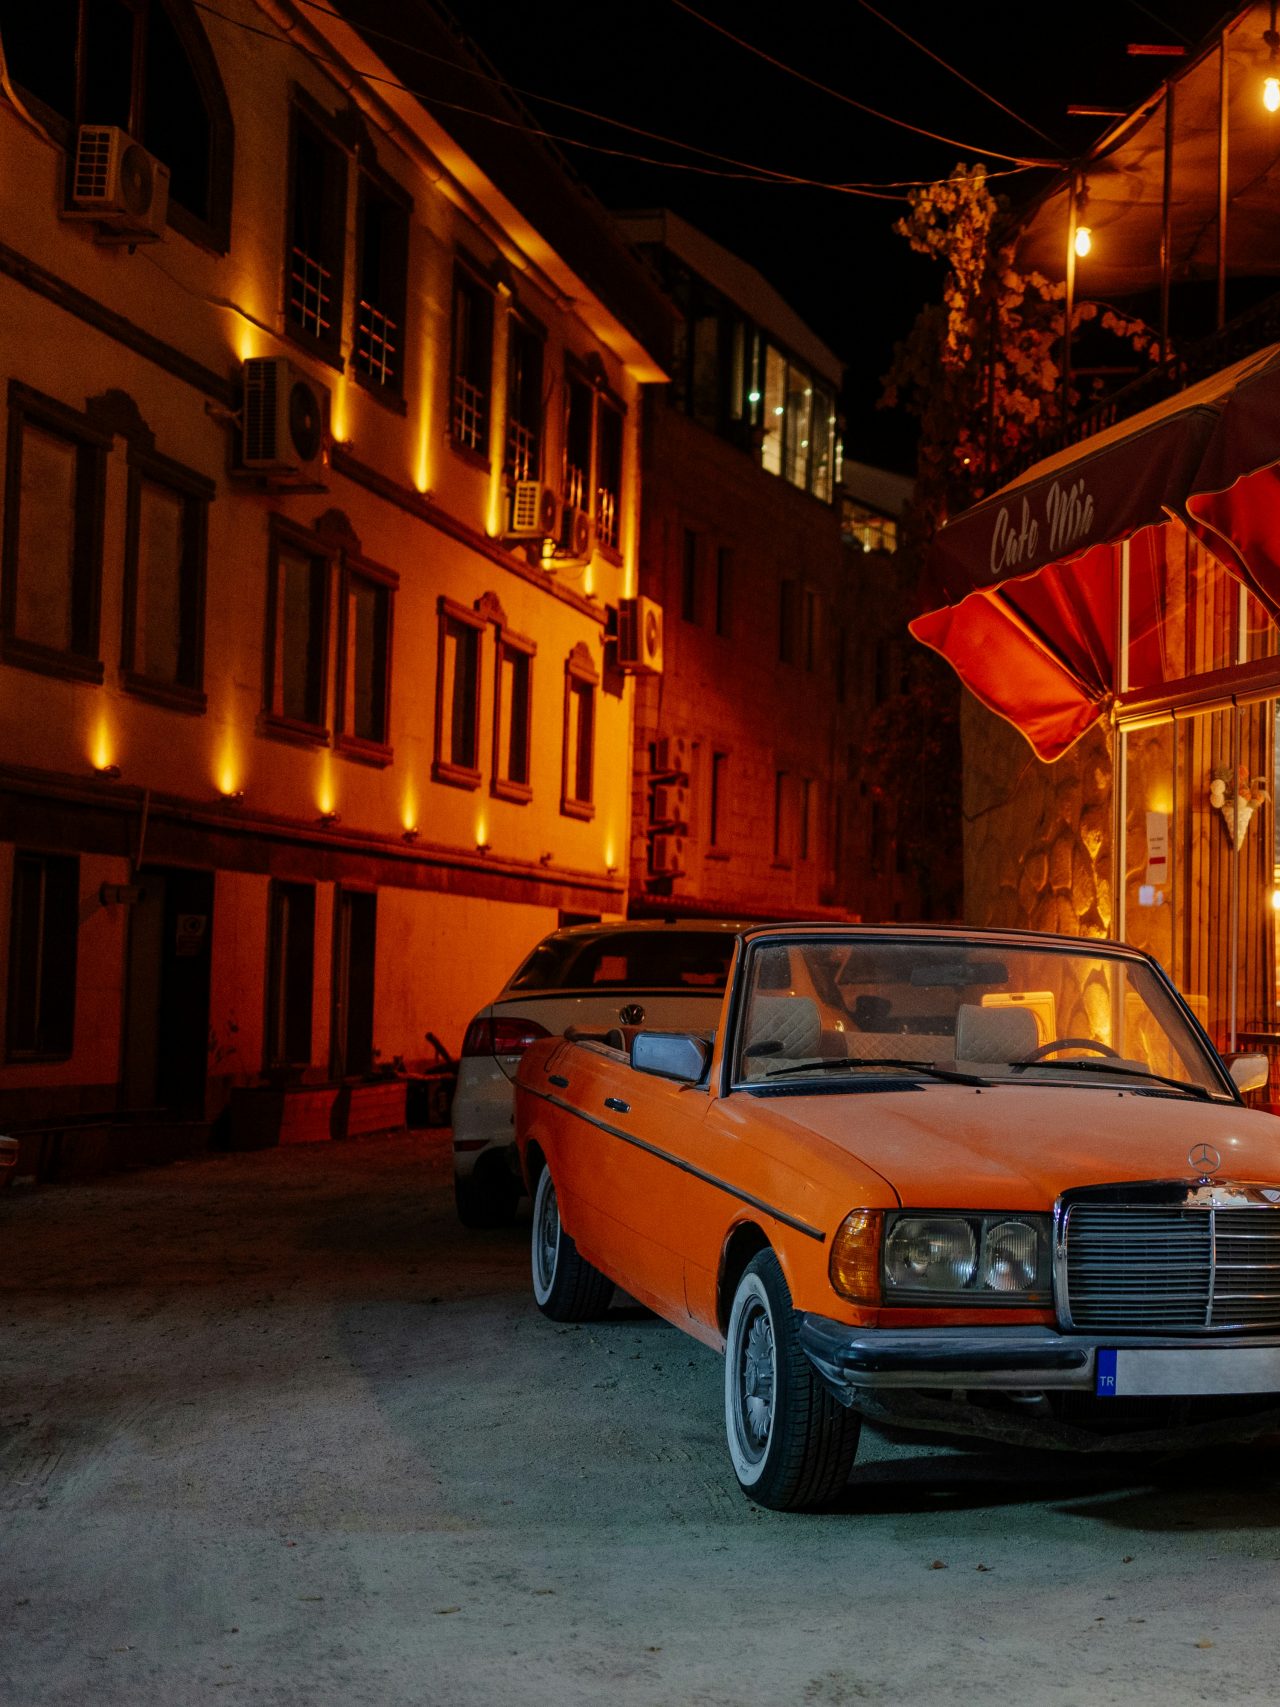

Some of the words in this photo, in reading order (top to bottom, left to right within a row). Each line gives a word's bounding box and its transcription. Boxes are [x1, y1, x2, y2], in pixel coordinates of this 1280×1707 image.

[990, 496, 1038, 574] Cafe
[1046, 478, 1094, 552] Mia
[1100, 1376, 1114, 1387] TR
